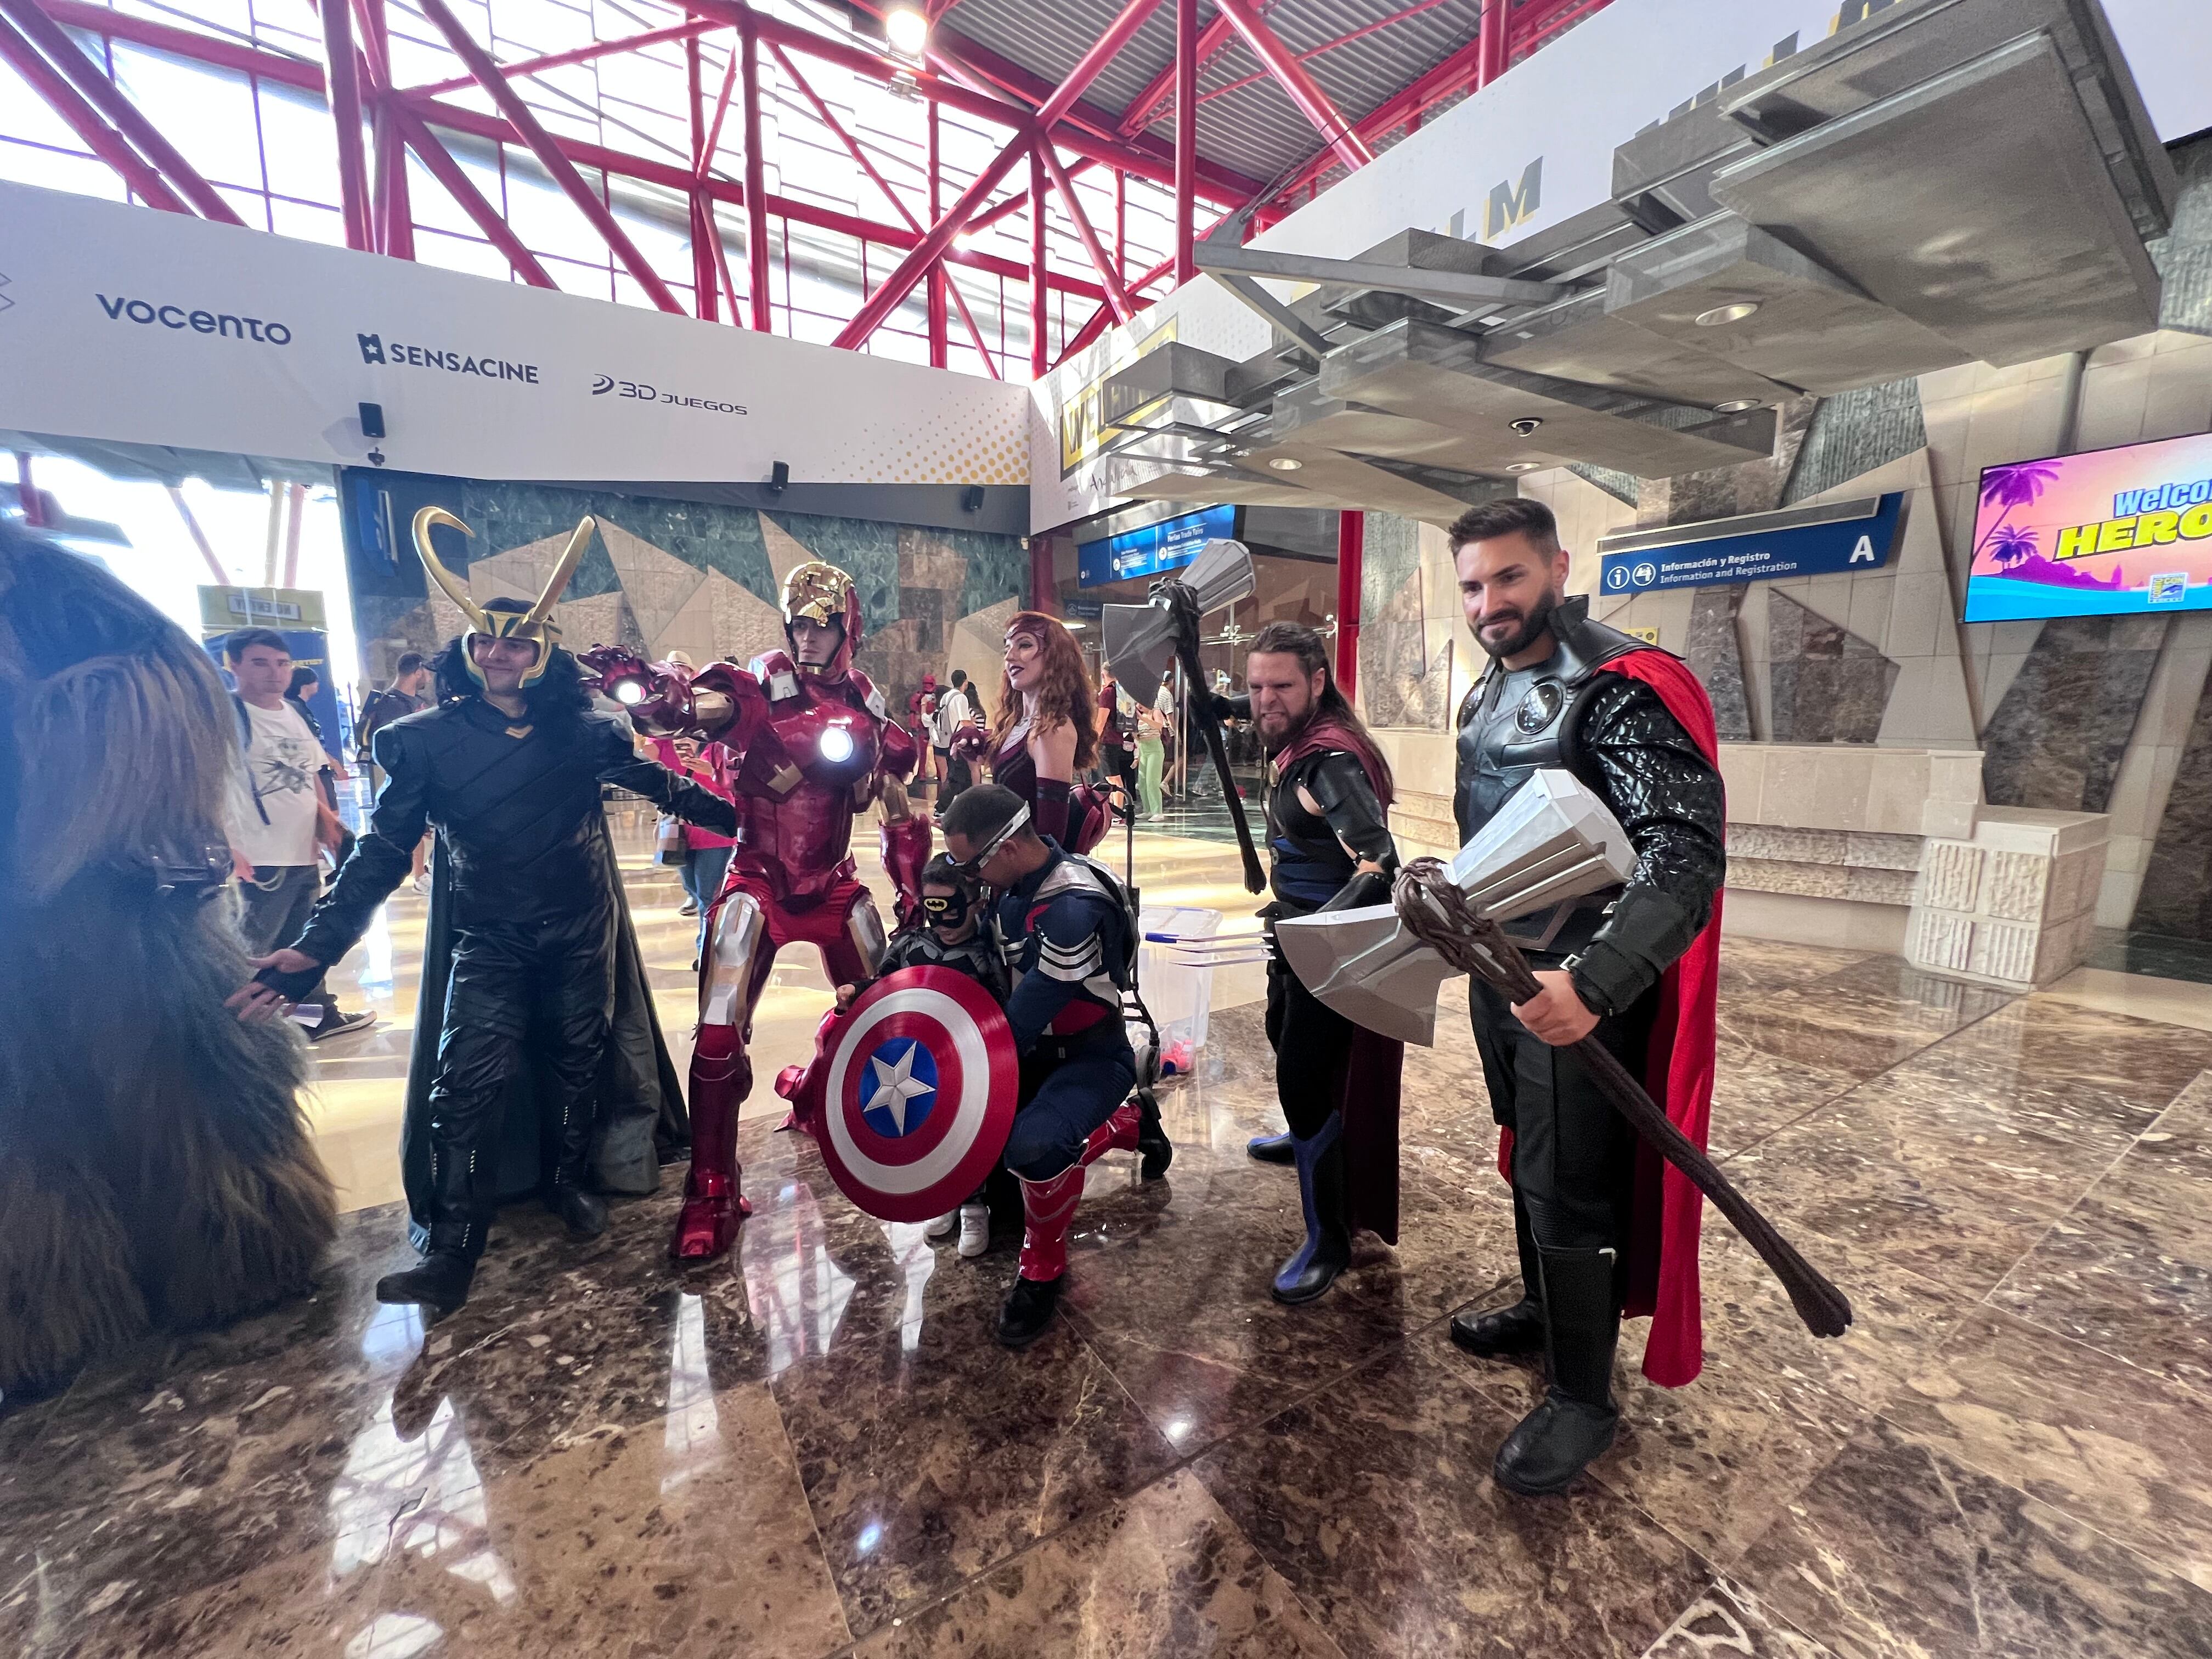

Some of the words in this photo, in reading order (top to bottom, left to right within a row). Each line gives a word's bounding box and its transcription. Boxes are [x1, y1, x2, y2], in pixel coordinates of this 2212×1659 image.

[95, 293, 291, 345] vocento
[390, 343, 539, 384] SENSACINE
[619, 381, 657, 400] 3D
[660, 393, 747, 415] JUEGOS
[2114, 479, 2212, 518] Welco
[1661, 557, 1717, 572] Información
[1720, 558, 1728, 567] y
[1728, 552, 1771, 565] Registro
[1849, 535, 1875, 563] A
[1660, 571, 1713, 584] Information
[1715, 567, 1733, 578] and
[1735, 561, 1797, 577] Registration
